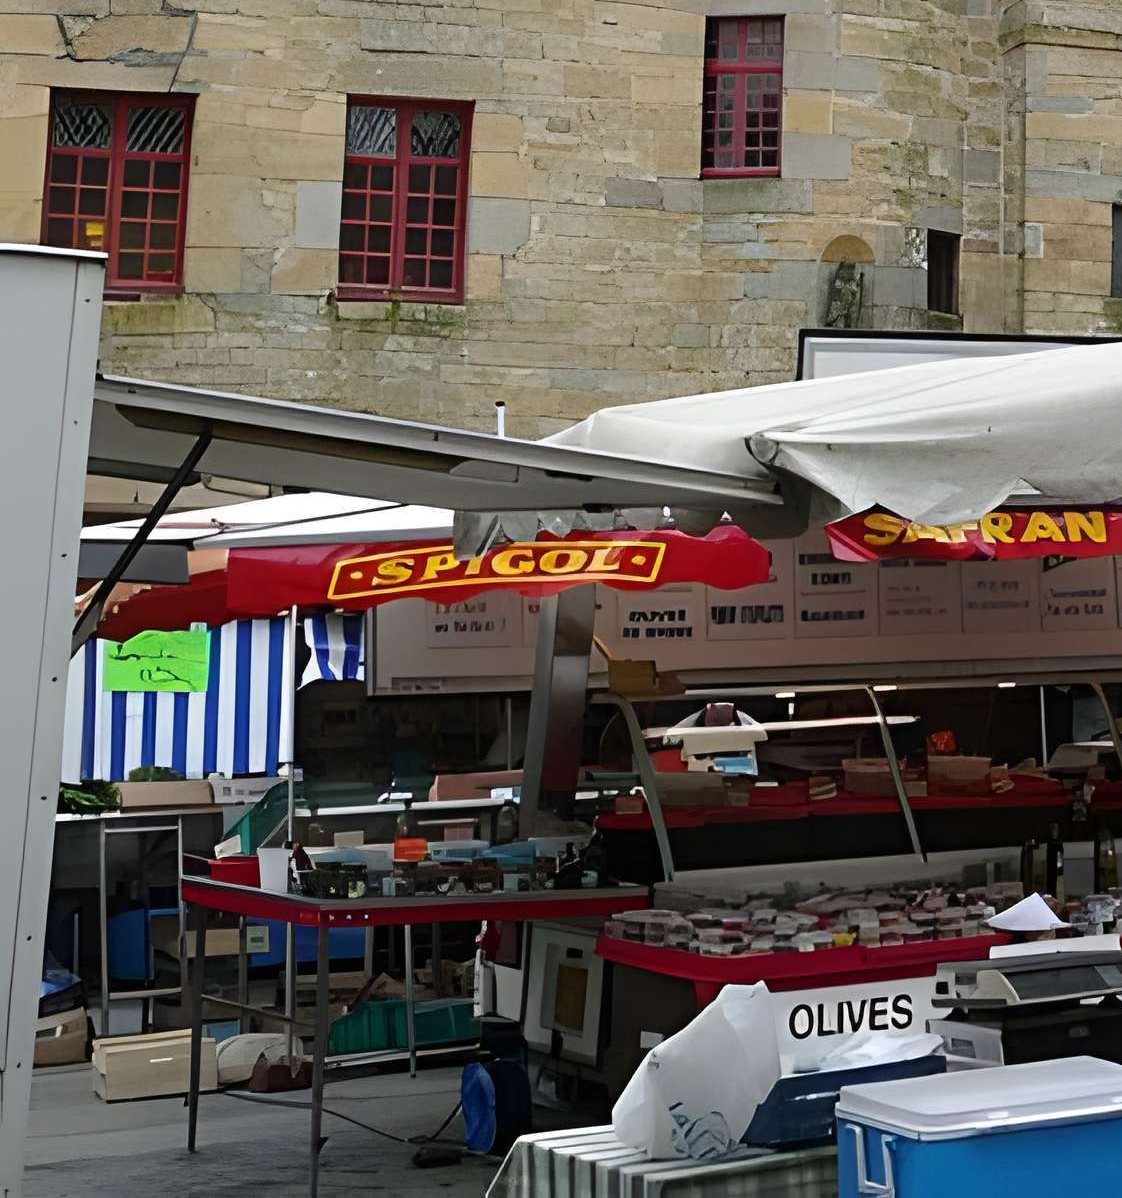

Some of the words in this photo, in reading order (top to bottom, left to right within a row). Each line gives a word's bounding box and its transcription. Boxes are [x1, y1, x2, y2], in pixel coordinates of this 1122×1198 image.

[864, 511, 1106, 544] SAFRAN
[371, 547, 625, 586] SPIGOL
[788, 993, 913, 1040] OLIVES
